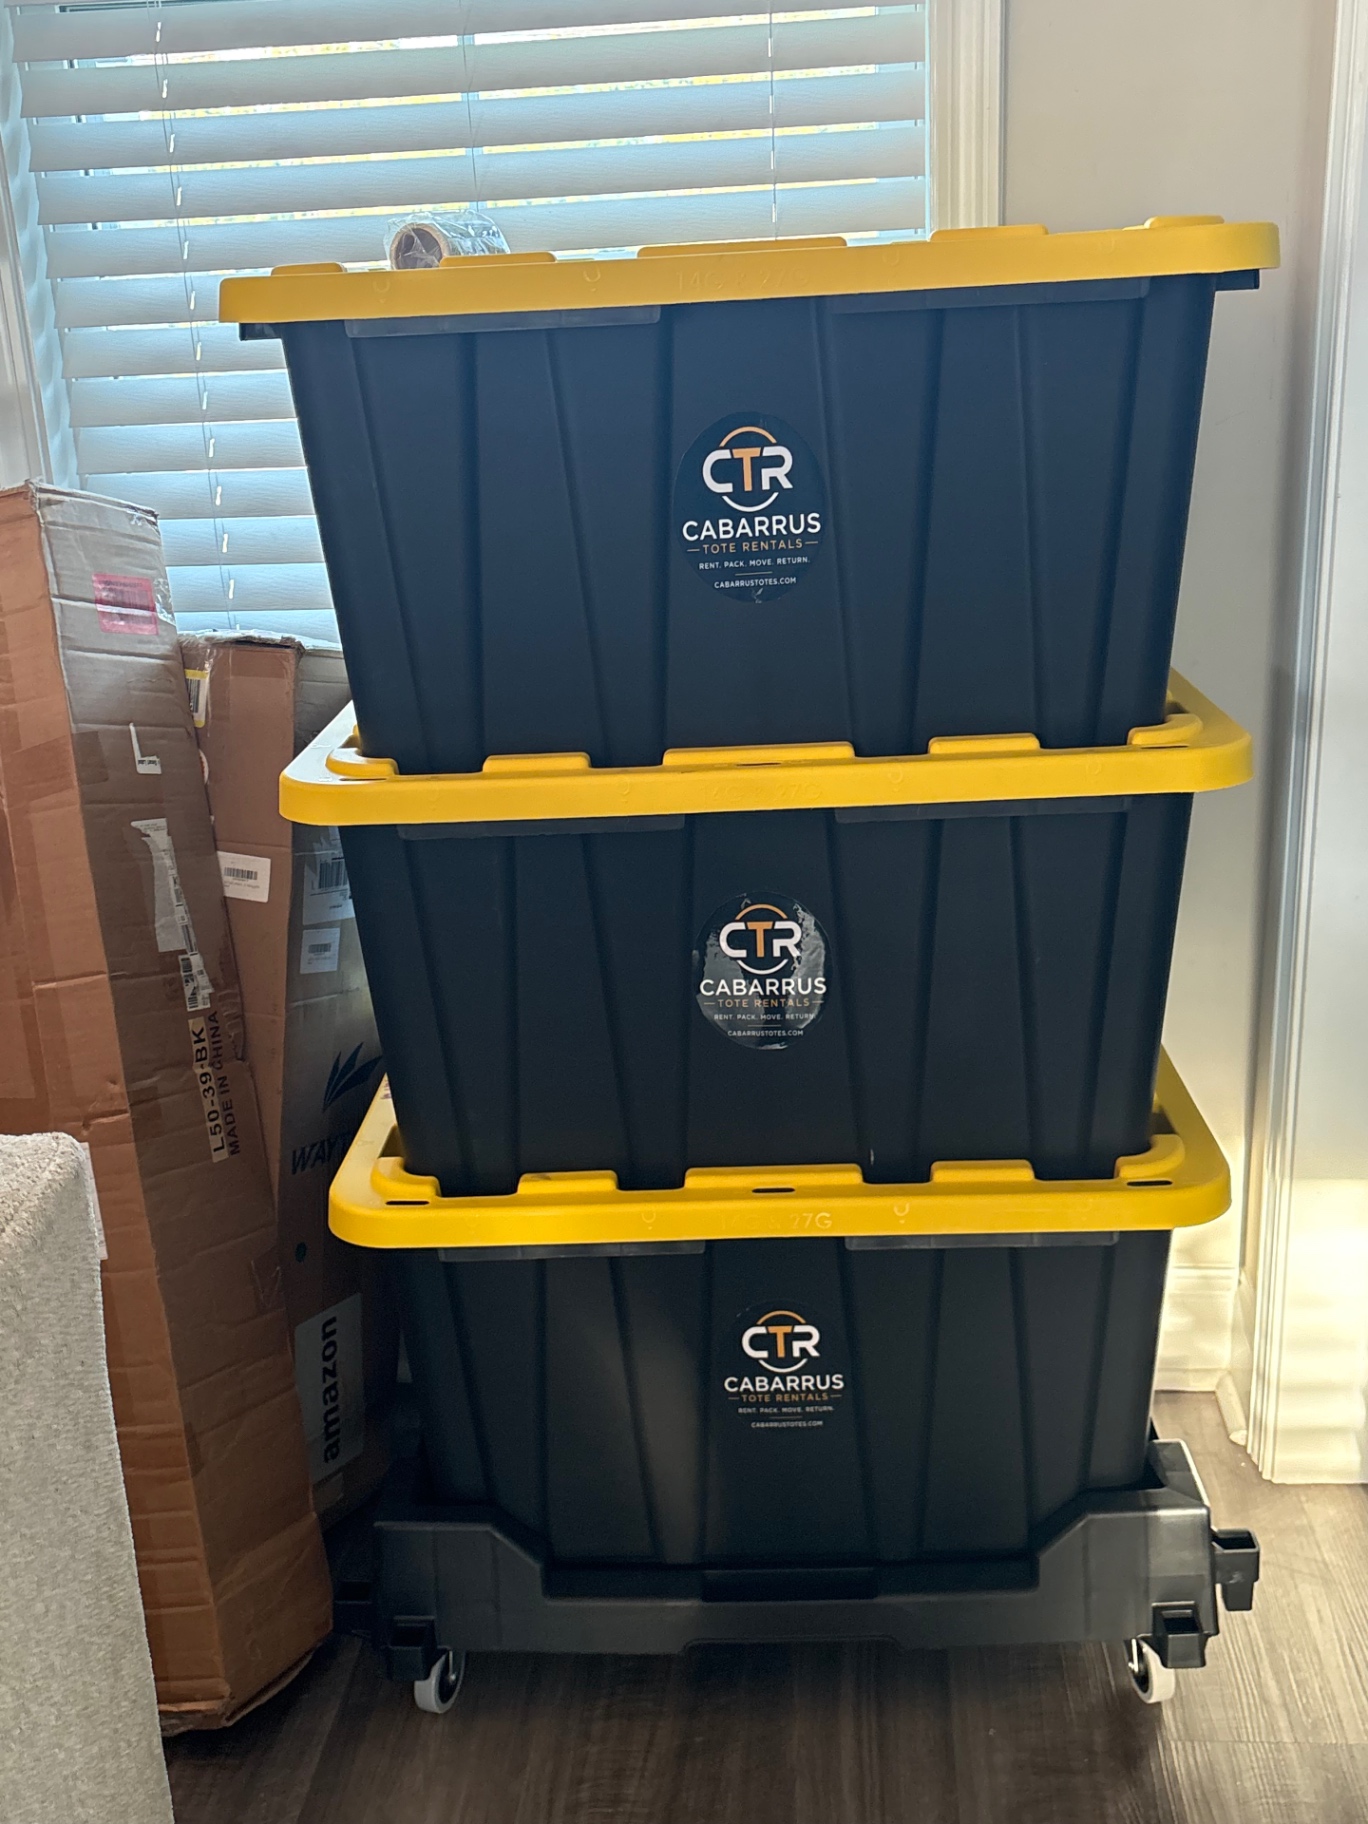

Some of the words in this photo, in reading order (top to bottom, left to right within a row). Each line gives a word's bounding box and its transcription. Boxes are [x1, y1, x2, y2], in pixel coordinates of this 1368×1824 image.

[702, 445, 793, 493] CTR
[682, 512, 821, 541] CABARRUS
[703, 542, 736, 554] TOTE
[742, 538, 803, 552] RENTALS
[698, 562, 721, 570] RENT.
[724, 560, 747, 568] PACK.
[776, 556, 811, 565] RETURN.
[714, 577, 797, 589] CABARRUSTOTES.COM
[719, 921, 802, 958] CTR
[699, 977, 827, 996] CABARRUS
[718, 999, 749, 1008] TOTE
[754, 998, 810, 1007] RENTALS
[207, 1011, 223, 1071] CHINA
[191, 1026, 226, 1153] L50-39-BK
[216, 1076, 230, 1095] IN
[222, 1099, 241, 1156] MADE
[741, 1325, 820, 1358] CTR
[321, 1316, 341, 1464] amazon
[724, 1374, 844, 1392] CABARRUS
[741, 1394, 771, 1402] TOTE
[775, 1393, 828, 1402] RENTALS
